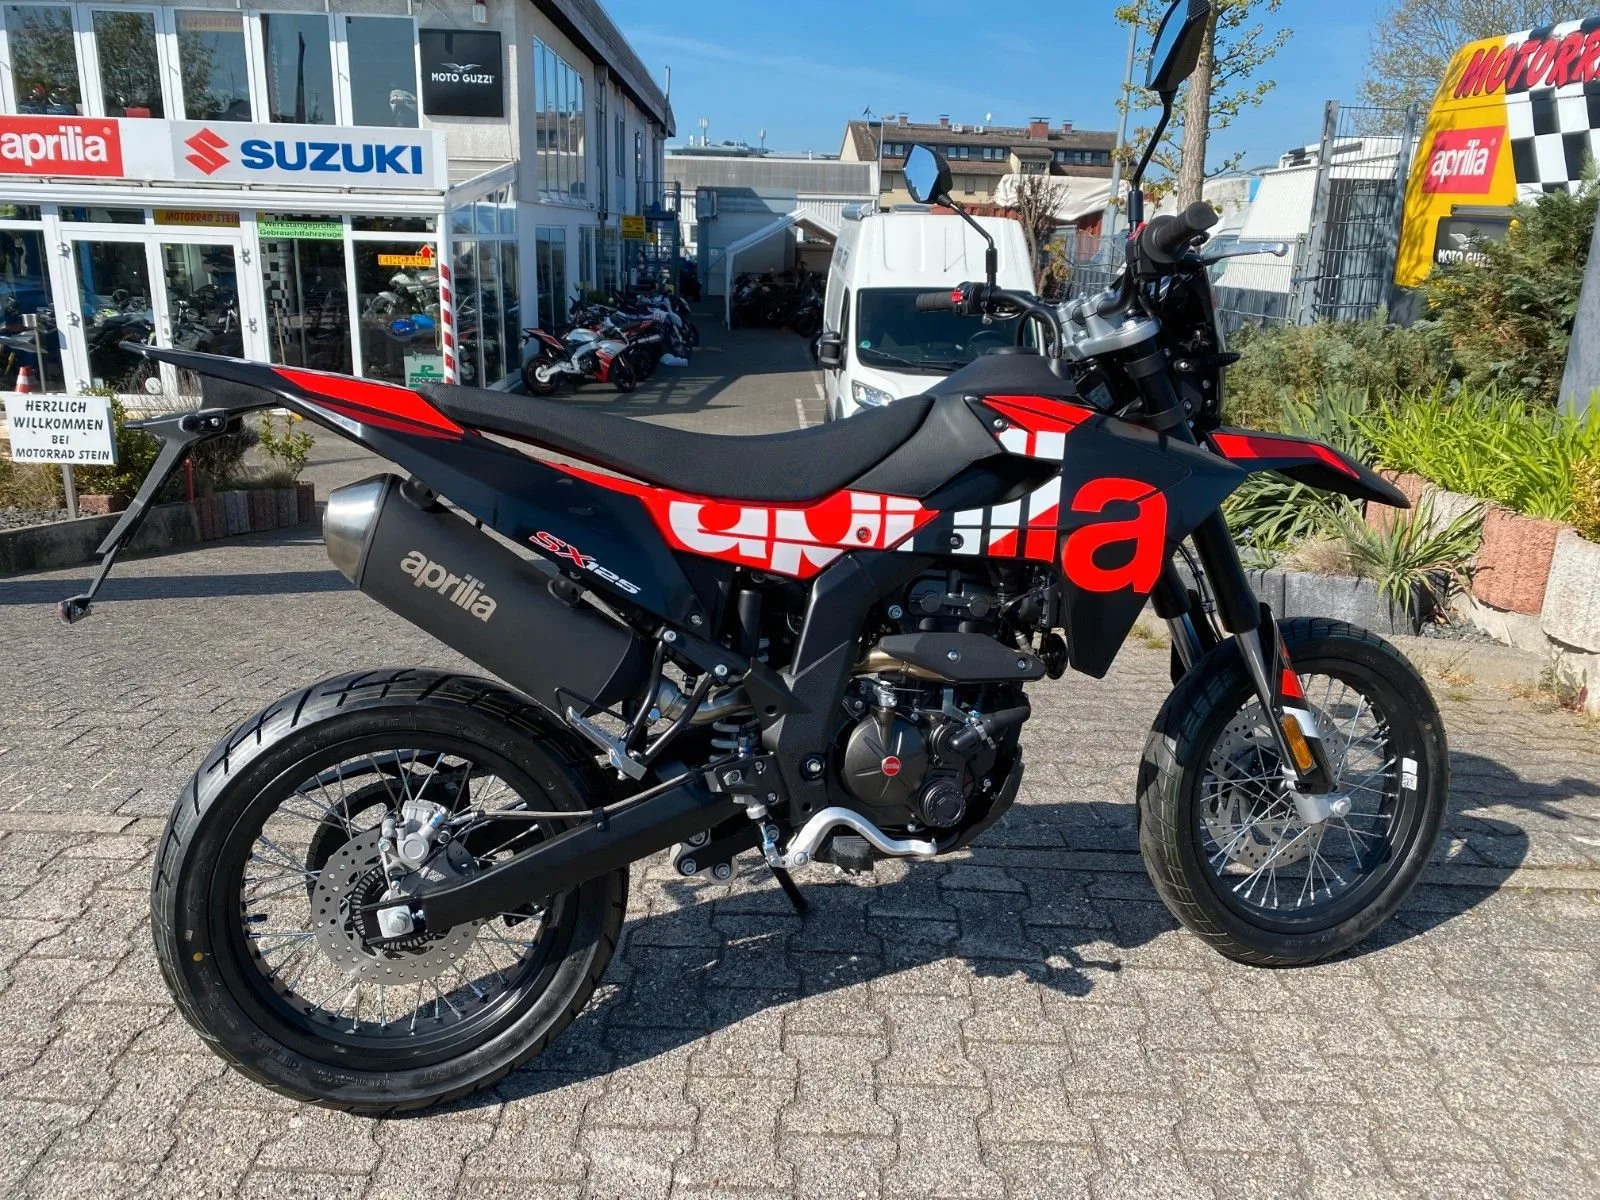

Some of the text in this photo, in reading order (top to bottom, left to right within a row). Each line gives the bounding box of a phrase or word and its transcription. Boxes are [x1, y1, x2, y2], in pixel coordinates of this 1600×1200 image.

[1453, 27, 1600, 99] MOTORR
[431, 72, 492, 84] MOTO GUZZI
[0, 125, 108, 167] aprilia
[240, 139, 423, 175] SUZUKI
[1431, 138, 1489, 184] aprilia
[165, 211, 213, 223] MOTORRAD
[259, 229, 342, 238] Gebrauchtfahrzeuge
[380, 255, 430, 265] EINGANG
[1438, 249, 1463, 264] MOTO
[26, 400, 87, 413] HERZLICH
[14, 416, 104, 430] WILLKOMMEN
[52, 434, 69, 445] BEI
[15, 447, 110, 460] MOTORRAD STEIN
[400, 550, 497, 623] aprilia
